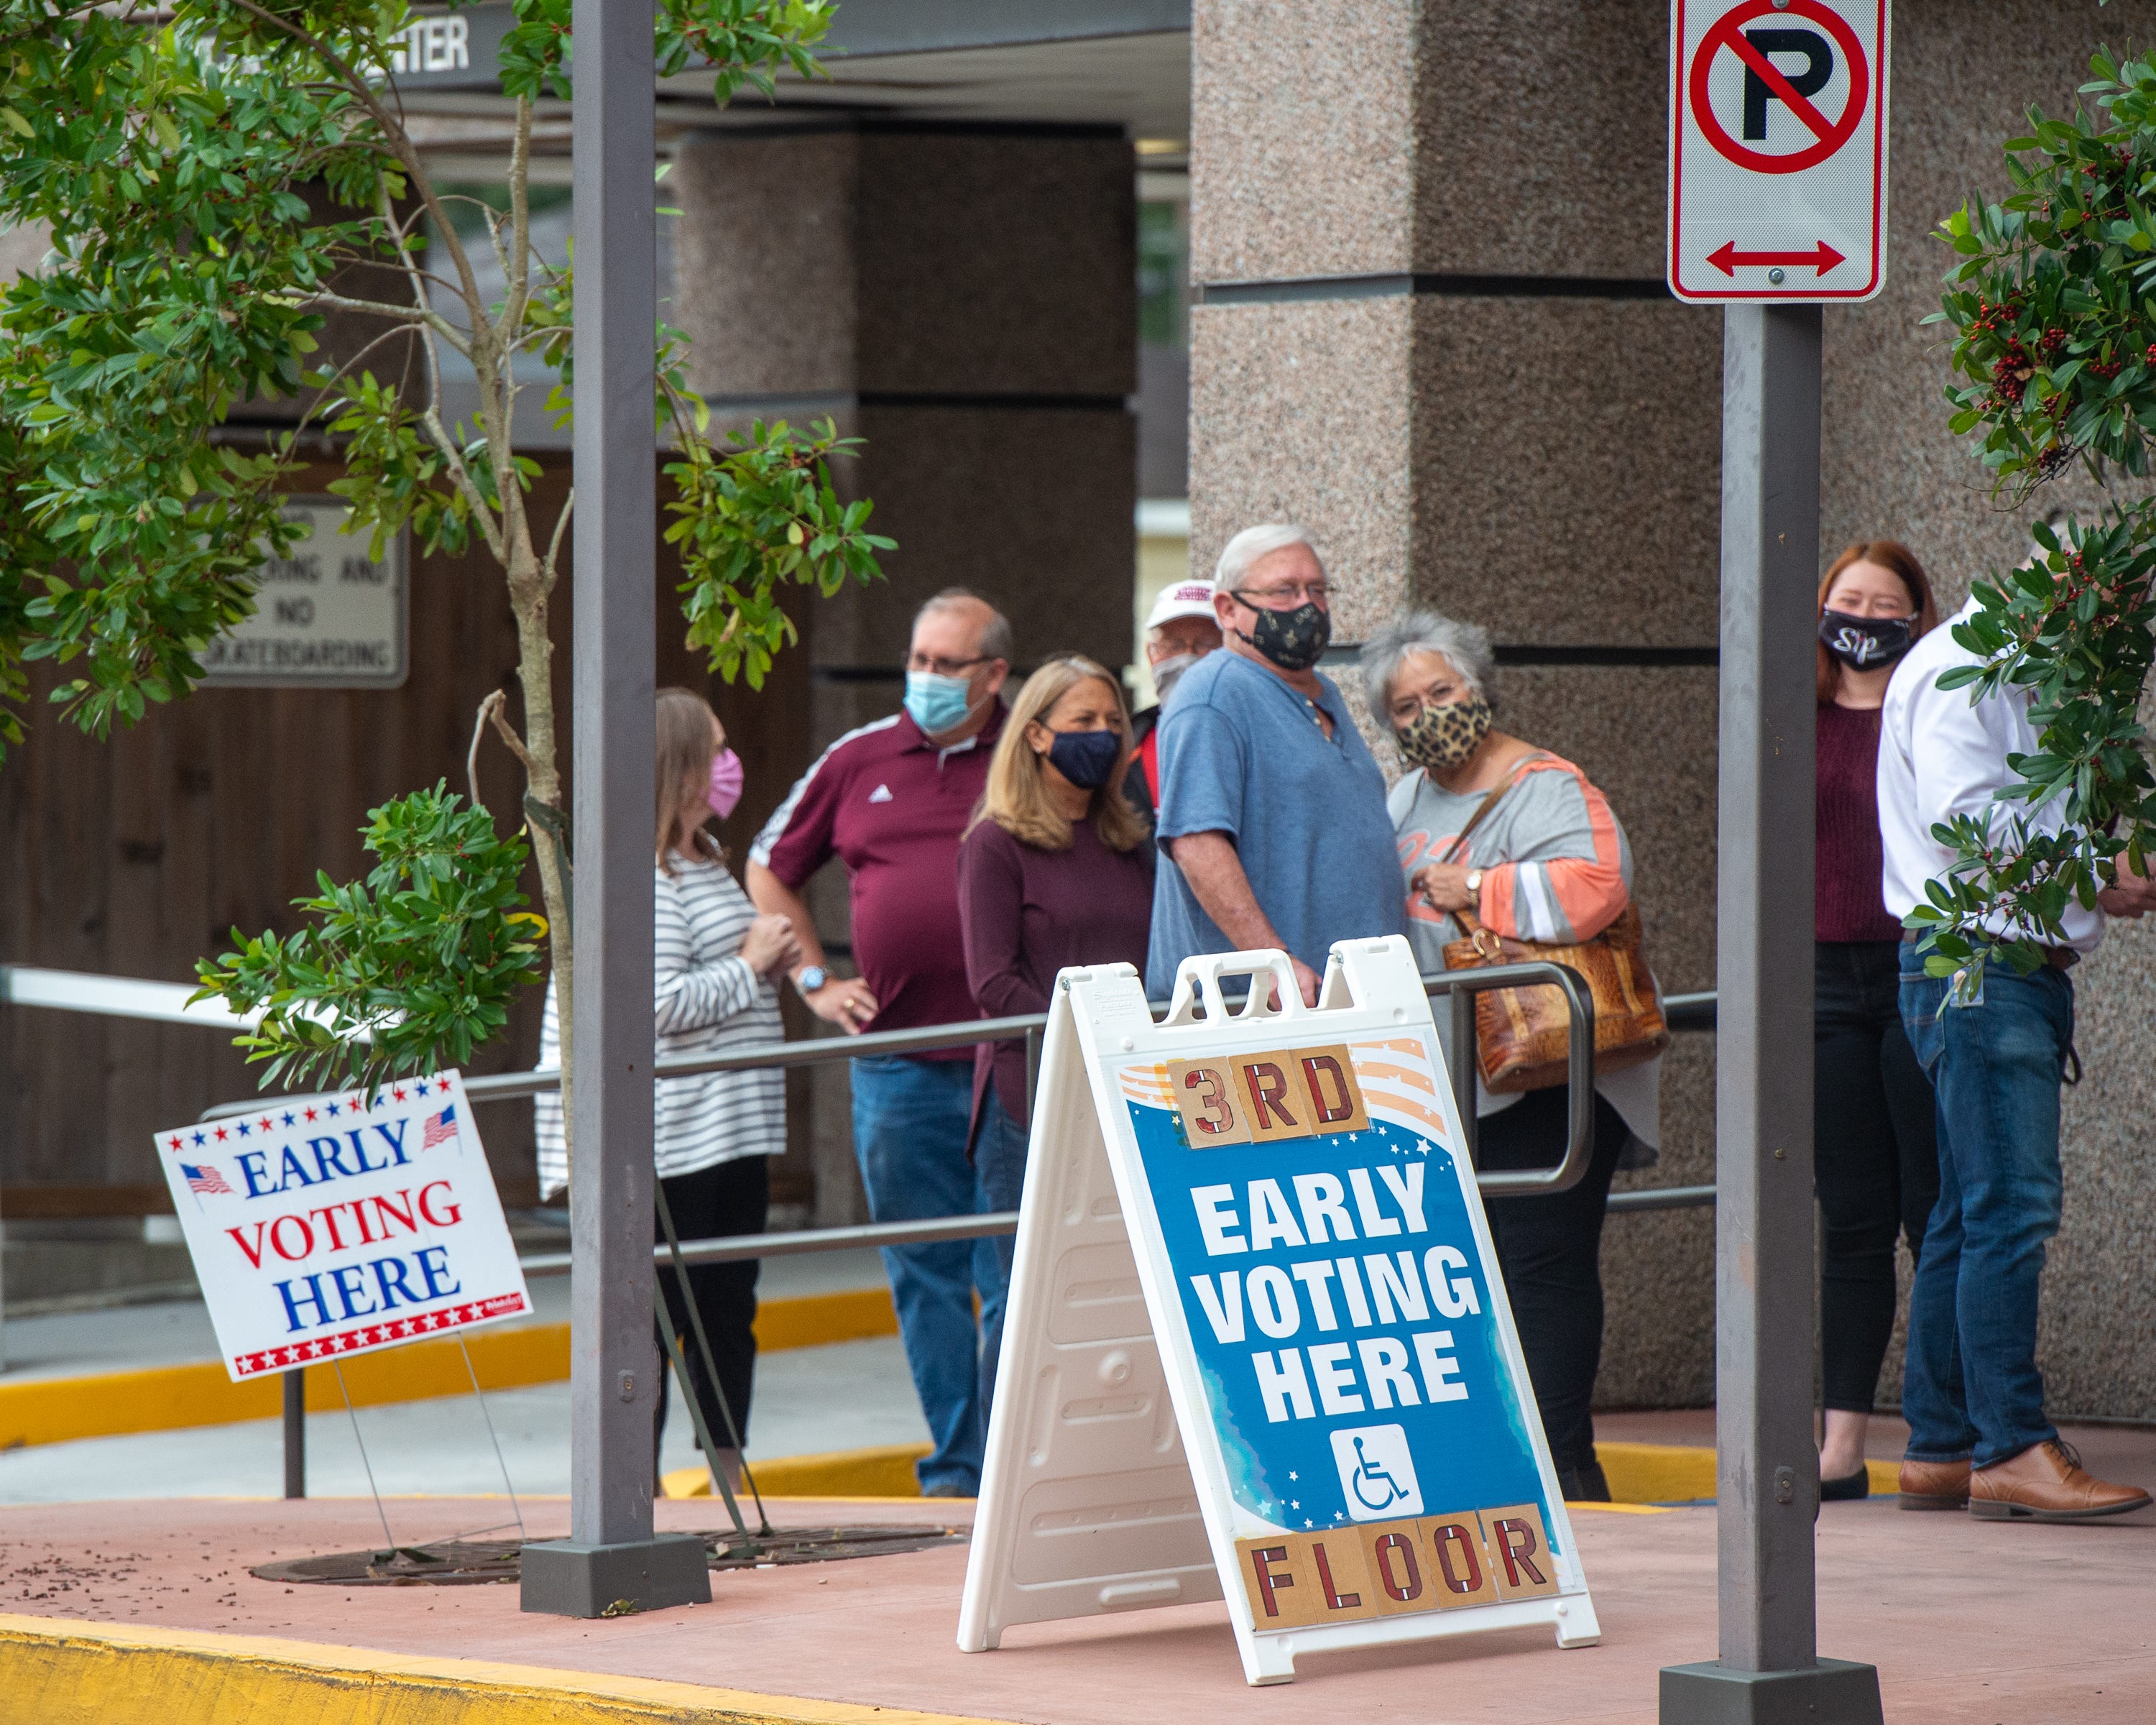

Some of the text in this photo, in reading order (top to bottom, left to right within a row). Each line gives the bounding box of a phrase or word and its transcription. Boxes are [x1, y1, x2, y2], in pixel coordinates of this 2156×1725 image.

[1743, 29, 1833, 139] P
[275, 596, 315, 628] NO
[1185, 1056, 1353, 1133] 3RD
[234, 1118, 413, 1200] EARLY
[224, 1180, 463, 1269] VOTING
[1189, 1162, 1430, 1256] EARLY
[272, 1245, 461, 1333] HERE
[1189, 1245, 1481, 1344] VOTING
[1250, 1330, 1470, 1423] HERE
[1250, 1518, 1547, 1617] FLOOR
